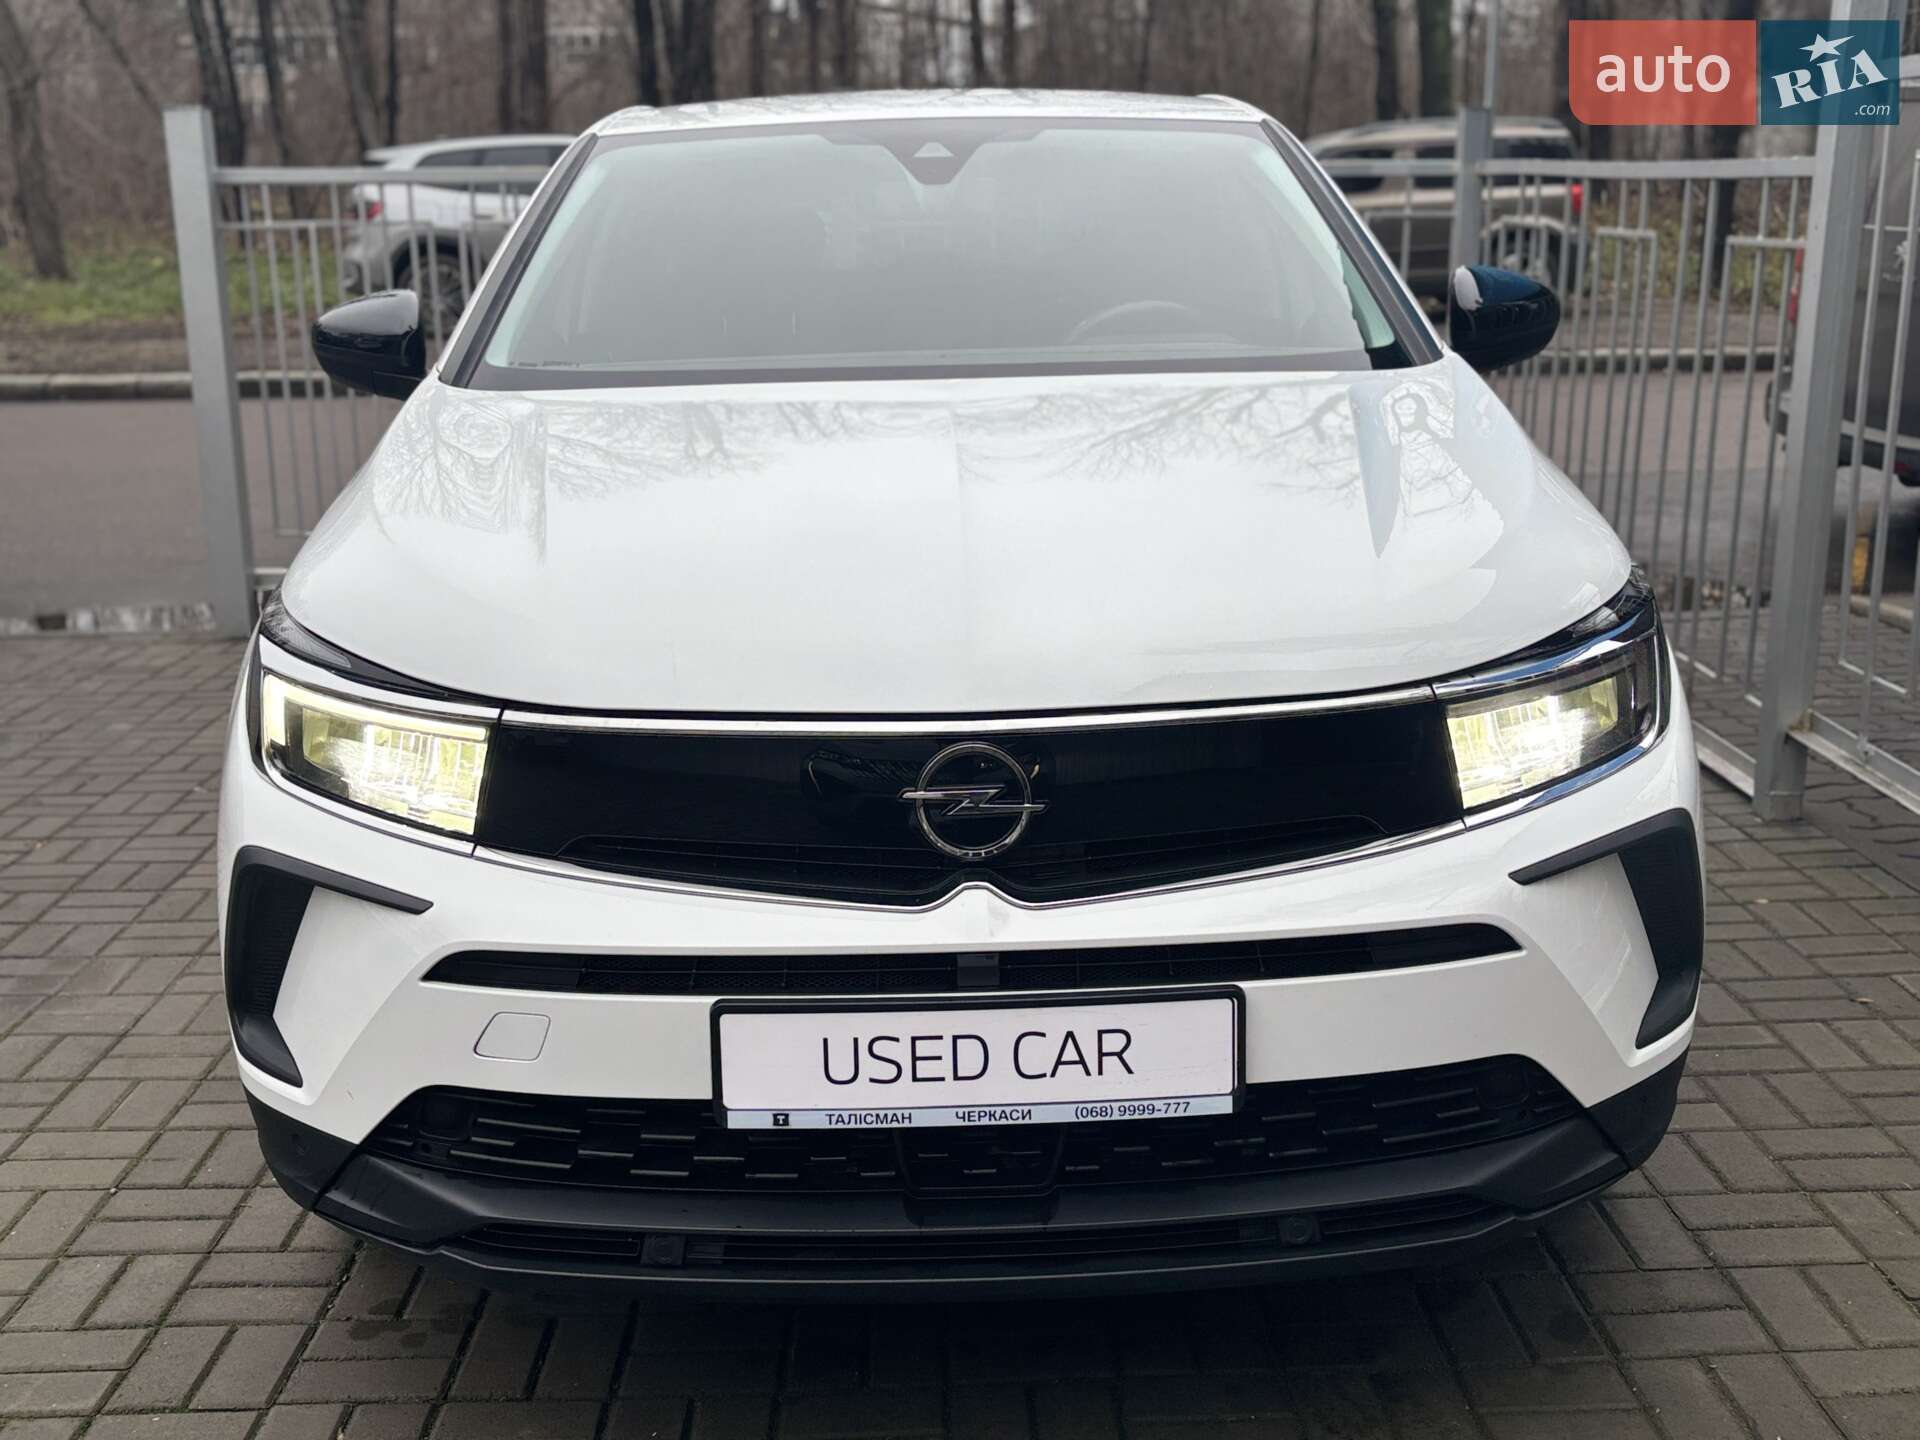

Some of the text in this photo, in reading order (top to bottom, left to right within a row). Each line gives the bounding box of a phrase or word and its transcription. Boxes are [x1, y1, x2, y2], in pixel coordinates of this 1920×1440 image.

[821, 1028, 1135, 1086] USED CAR
[825, 1112, 913, 1126] ТАЛІСМАН
[955, 1108, 1033, 1123] ЧЕРКАСИ
[1074, 1103, 1114, 1120] (068)
[1117, 1101, 1191, 1117] 9999-777
